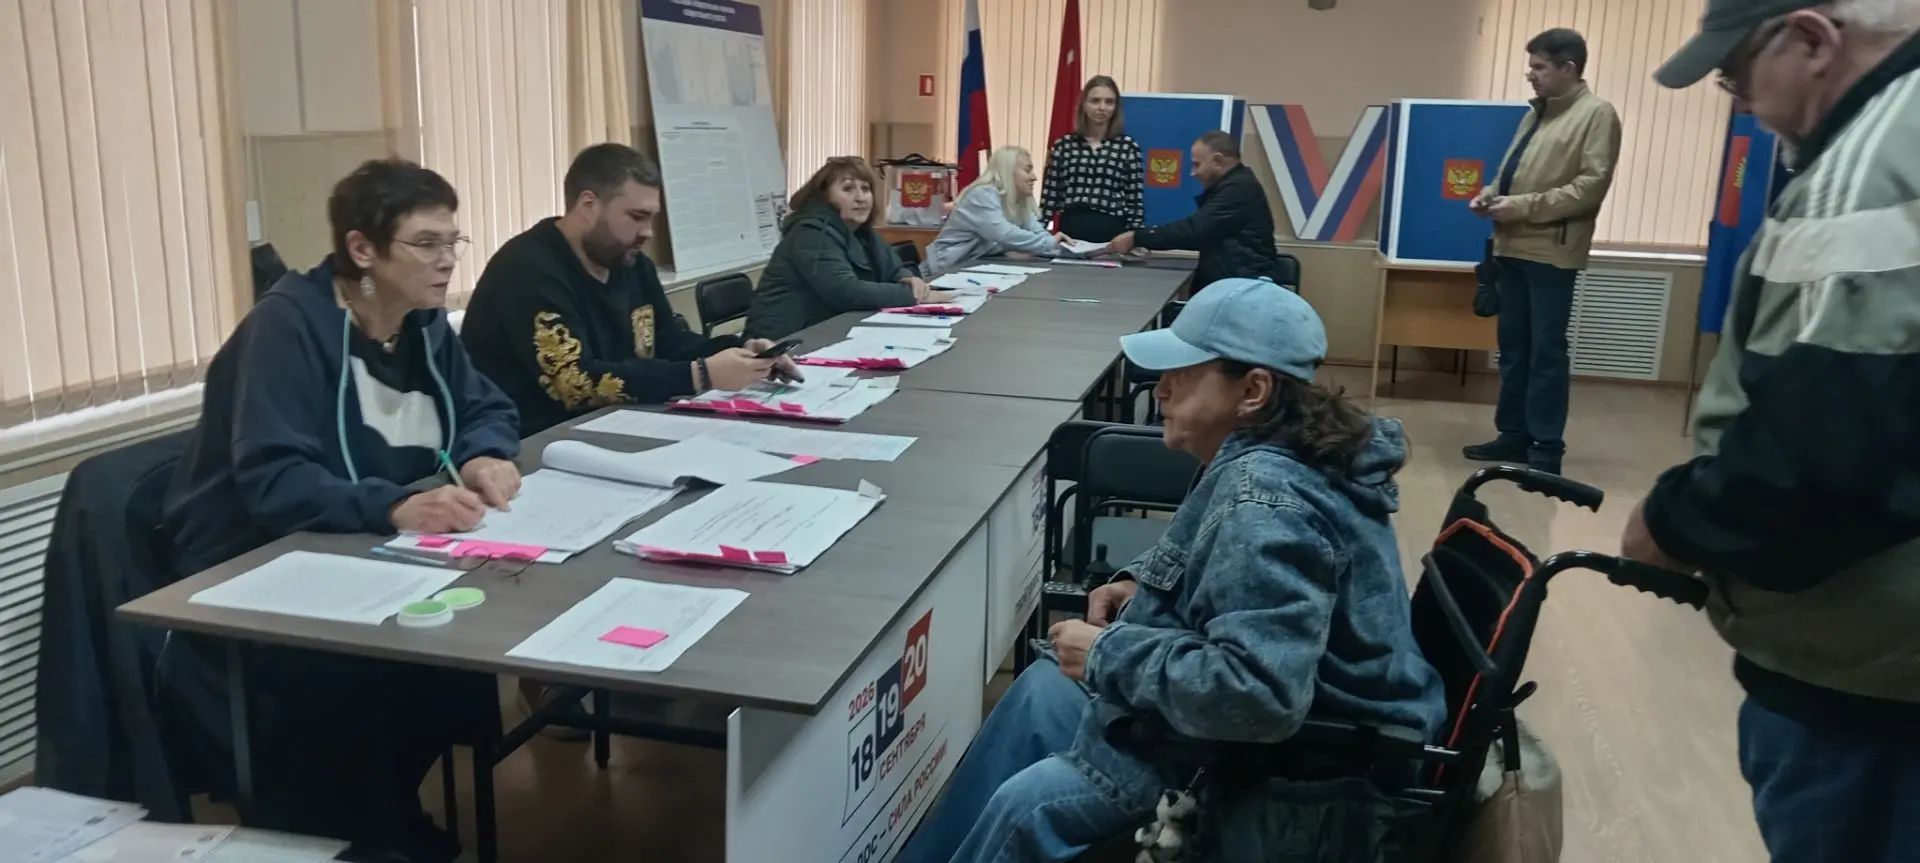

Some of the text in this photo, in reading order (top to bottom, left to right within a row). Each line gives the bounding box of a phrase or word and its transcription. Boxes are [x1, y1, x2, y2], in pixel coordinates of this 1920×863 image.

[848, 681, 874, 721] 2026
[852, 635, 926, 791] 18 19 20
[879, 713, 926, 781] СЕНТЯБРЯ
